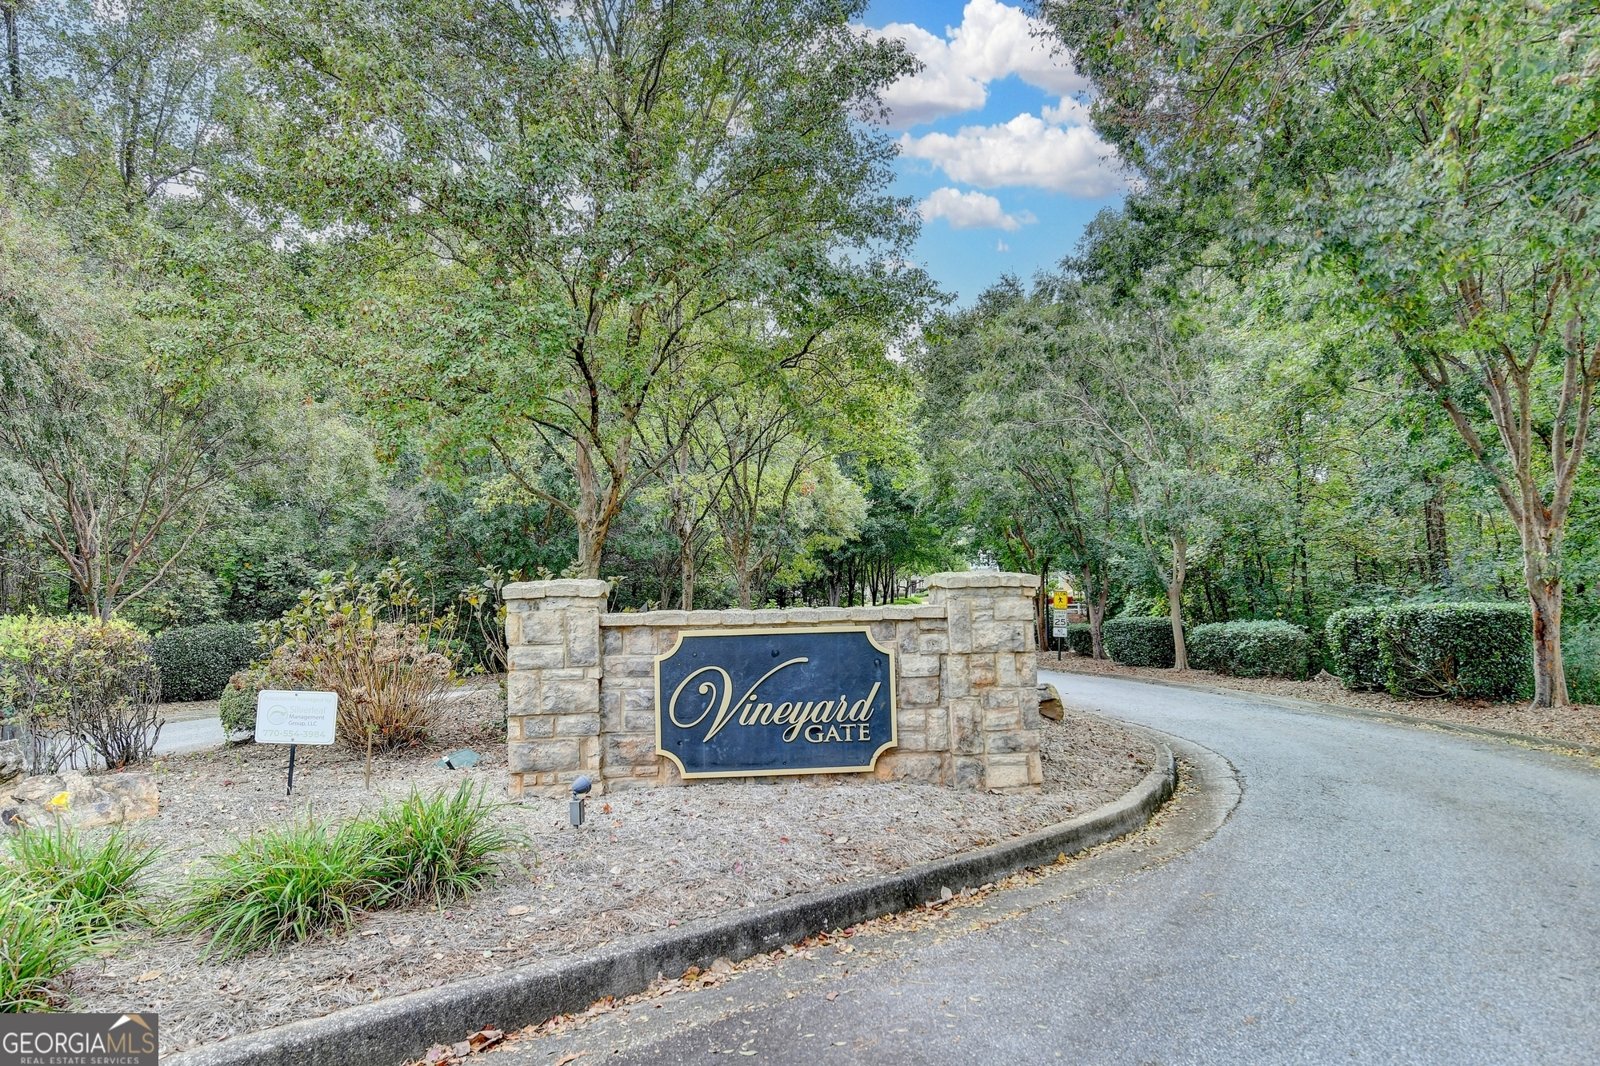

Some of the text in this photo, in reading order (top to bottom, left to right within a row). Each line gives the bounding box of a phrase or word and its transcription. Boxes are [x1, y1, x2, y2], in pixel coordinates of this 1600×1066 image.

[669, 657, 882, 743] Vineyard
[263, 729, 326, 738] 770-554-3984
[804, 723, 871, 743] GATE
